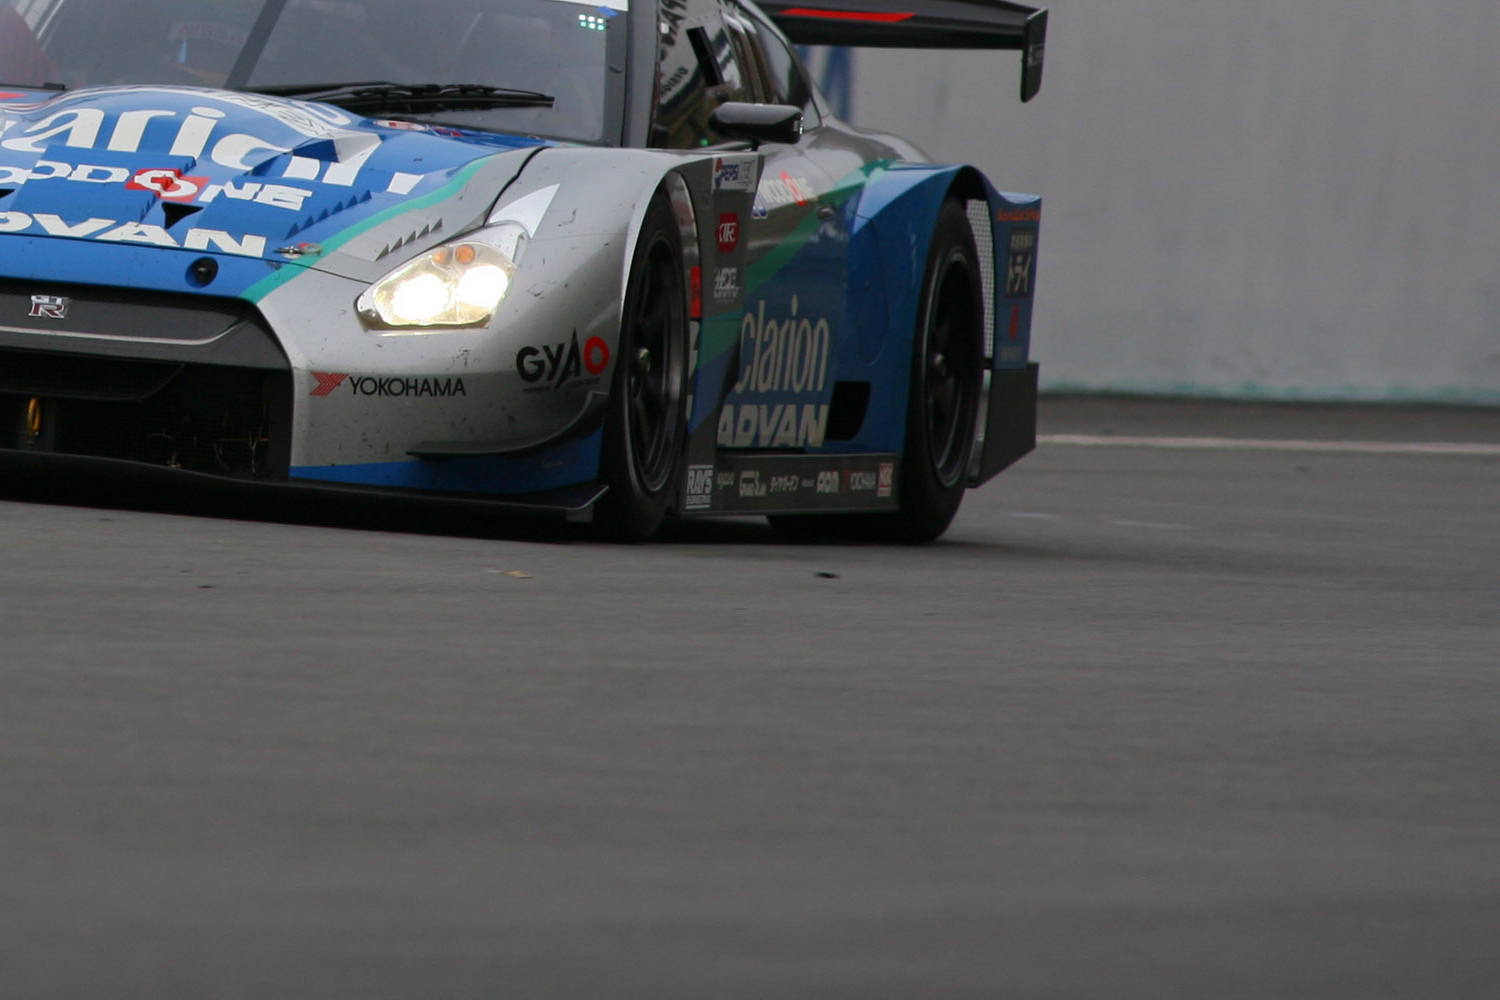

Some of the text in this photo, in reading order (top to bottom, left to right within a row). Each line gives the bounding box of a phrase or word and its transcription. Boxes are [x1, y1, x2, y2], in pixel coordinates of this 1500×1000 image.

[516, 328, 610, 390] GYAO
[735, 294, 830, 394] clarion
[348, 375, 467, 397] YOKOHAMA
[716, 404, 828, 449] ADVAN
